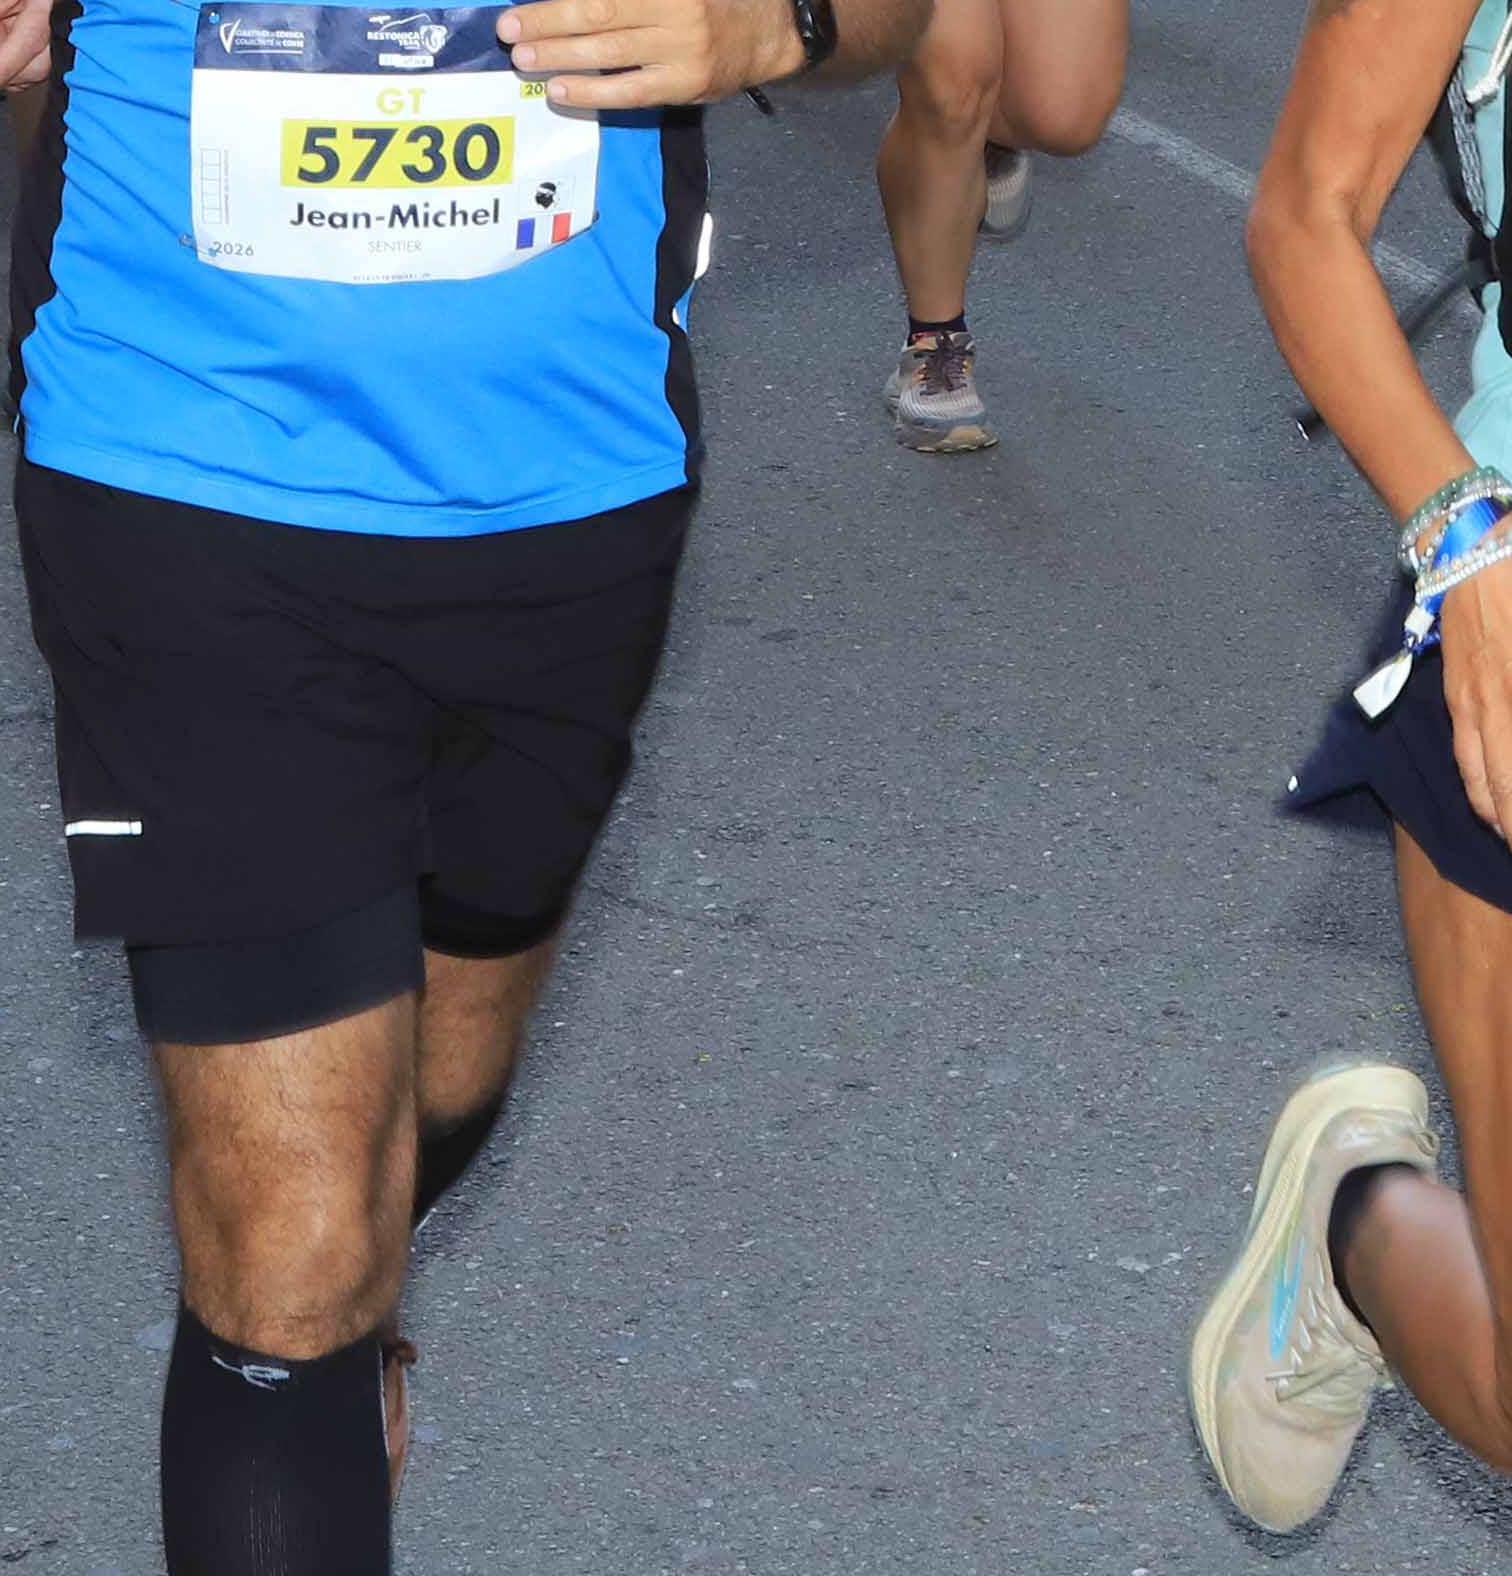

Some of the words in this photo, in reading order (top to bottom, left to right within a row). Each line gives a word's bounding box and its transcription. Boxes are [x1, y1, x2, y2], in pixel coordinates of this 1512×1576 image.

[525, 83, 544, 96] 20
[376, 87, 427, 115] GT
[297, 122, 501, 183] 5730
[289, 198, 500, 230] Jean-Michel
[214, 240, 255, 257] 2026
[367, 239, 423, 254] SENTIER
